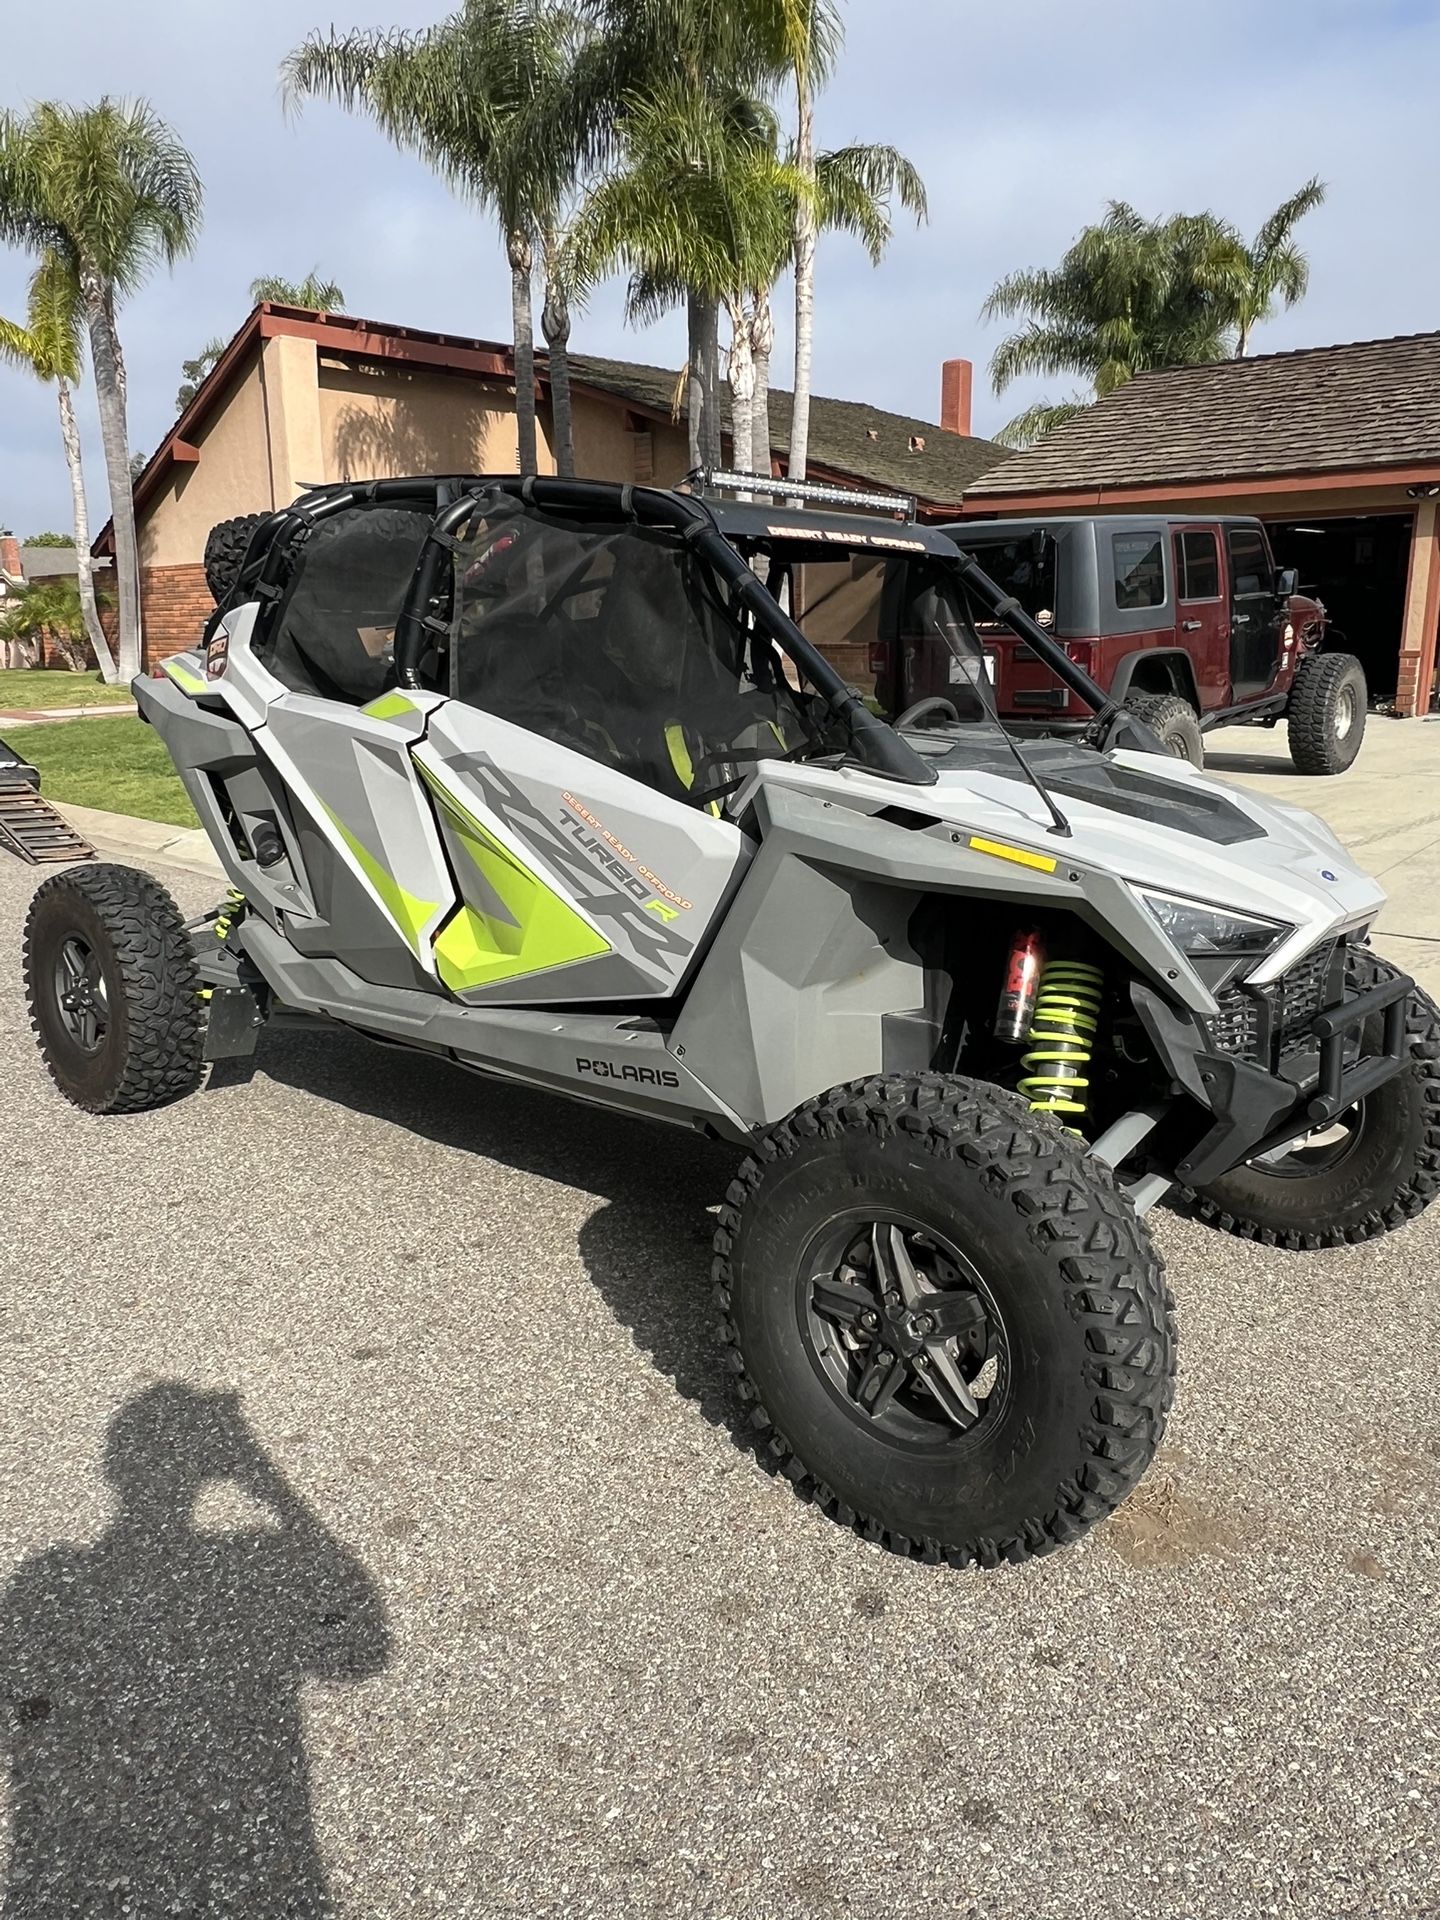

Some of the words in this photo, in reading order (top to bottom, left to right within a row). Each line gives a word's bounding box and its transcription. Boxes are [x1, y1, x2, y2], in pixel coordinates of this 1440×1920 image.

[442, 751, 694, 976] RZR
[560, 809, 651, 900] TURBO
[645, 900, 679, 922] R
[562, 791, 602, 829] DESERT
[602, 830, 638, 863] READY
[638, 865, 692, 909] OFFROAD
[576, 1058, 680, 1088] POLARIS
